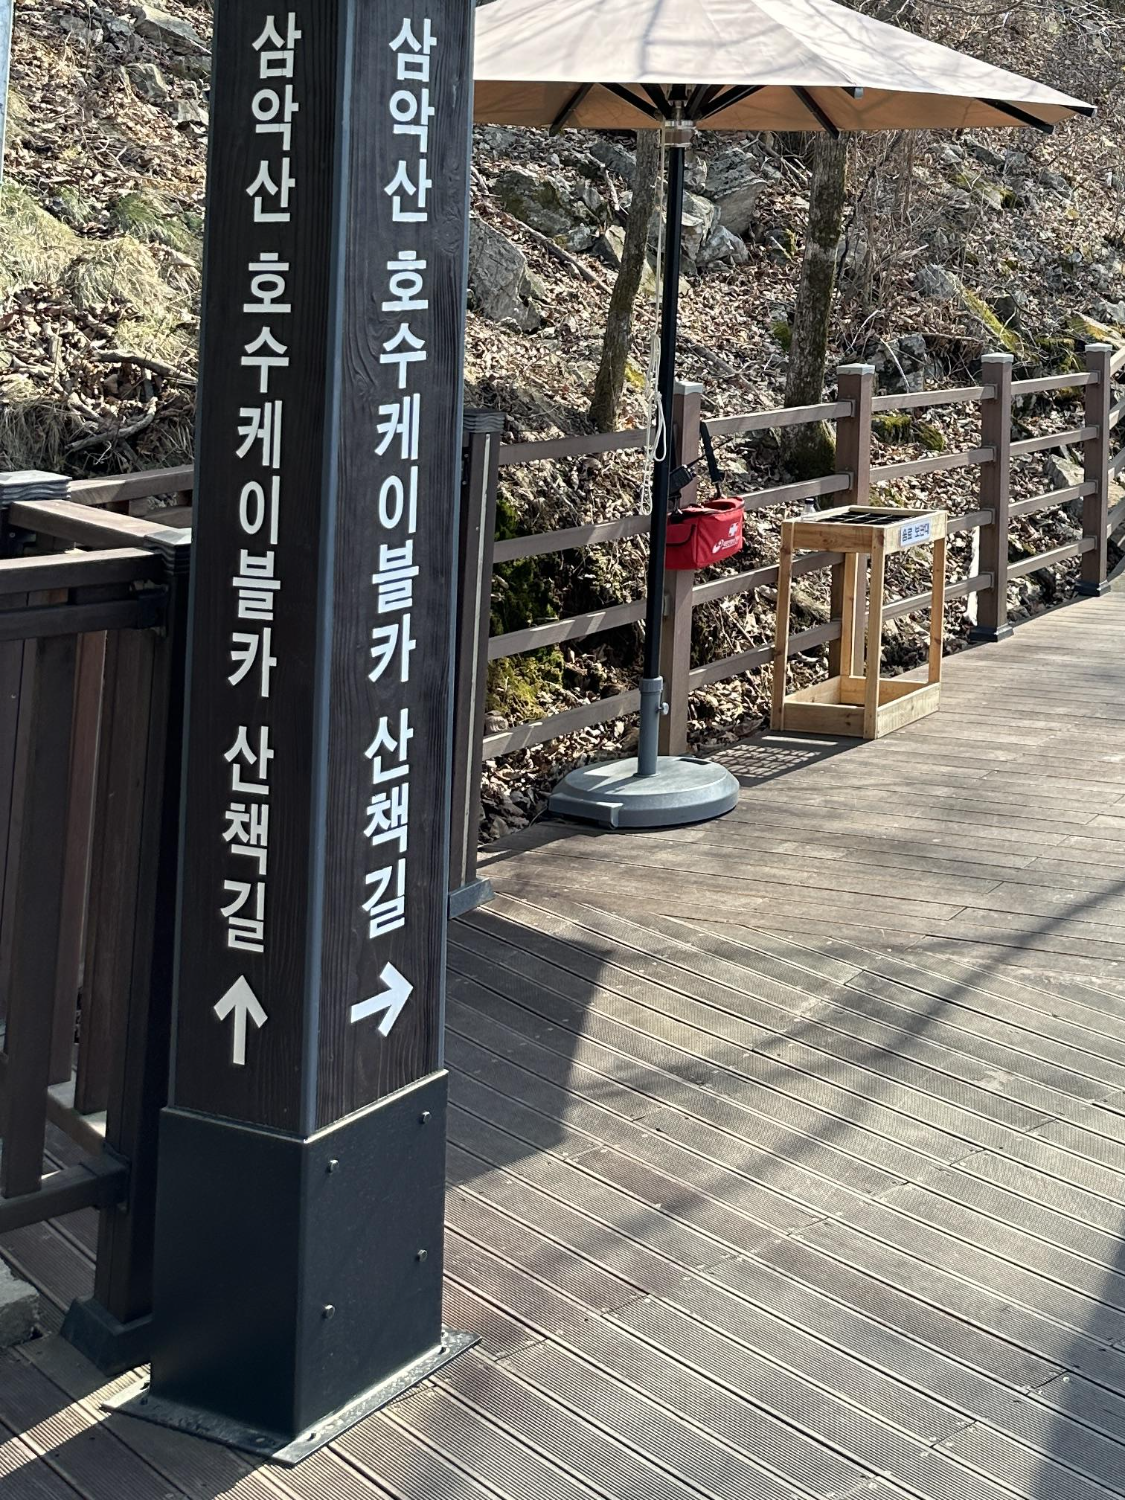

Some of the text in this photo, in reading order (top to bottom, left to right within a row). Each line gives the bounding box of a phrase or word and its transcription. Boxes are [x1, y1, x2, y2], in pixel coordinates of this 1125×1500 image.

[221, 12, 301, 953] 삼악산 호수케이블카 산책길
[362, 17, 437, 940] 삼악산 호수케이블카 산책길
